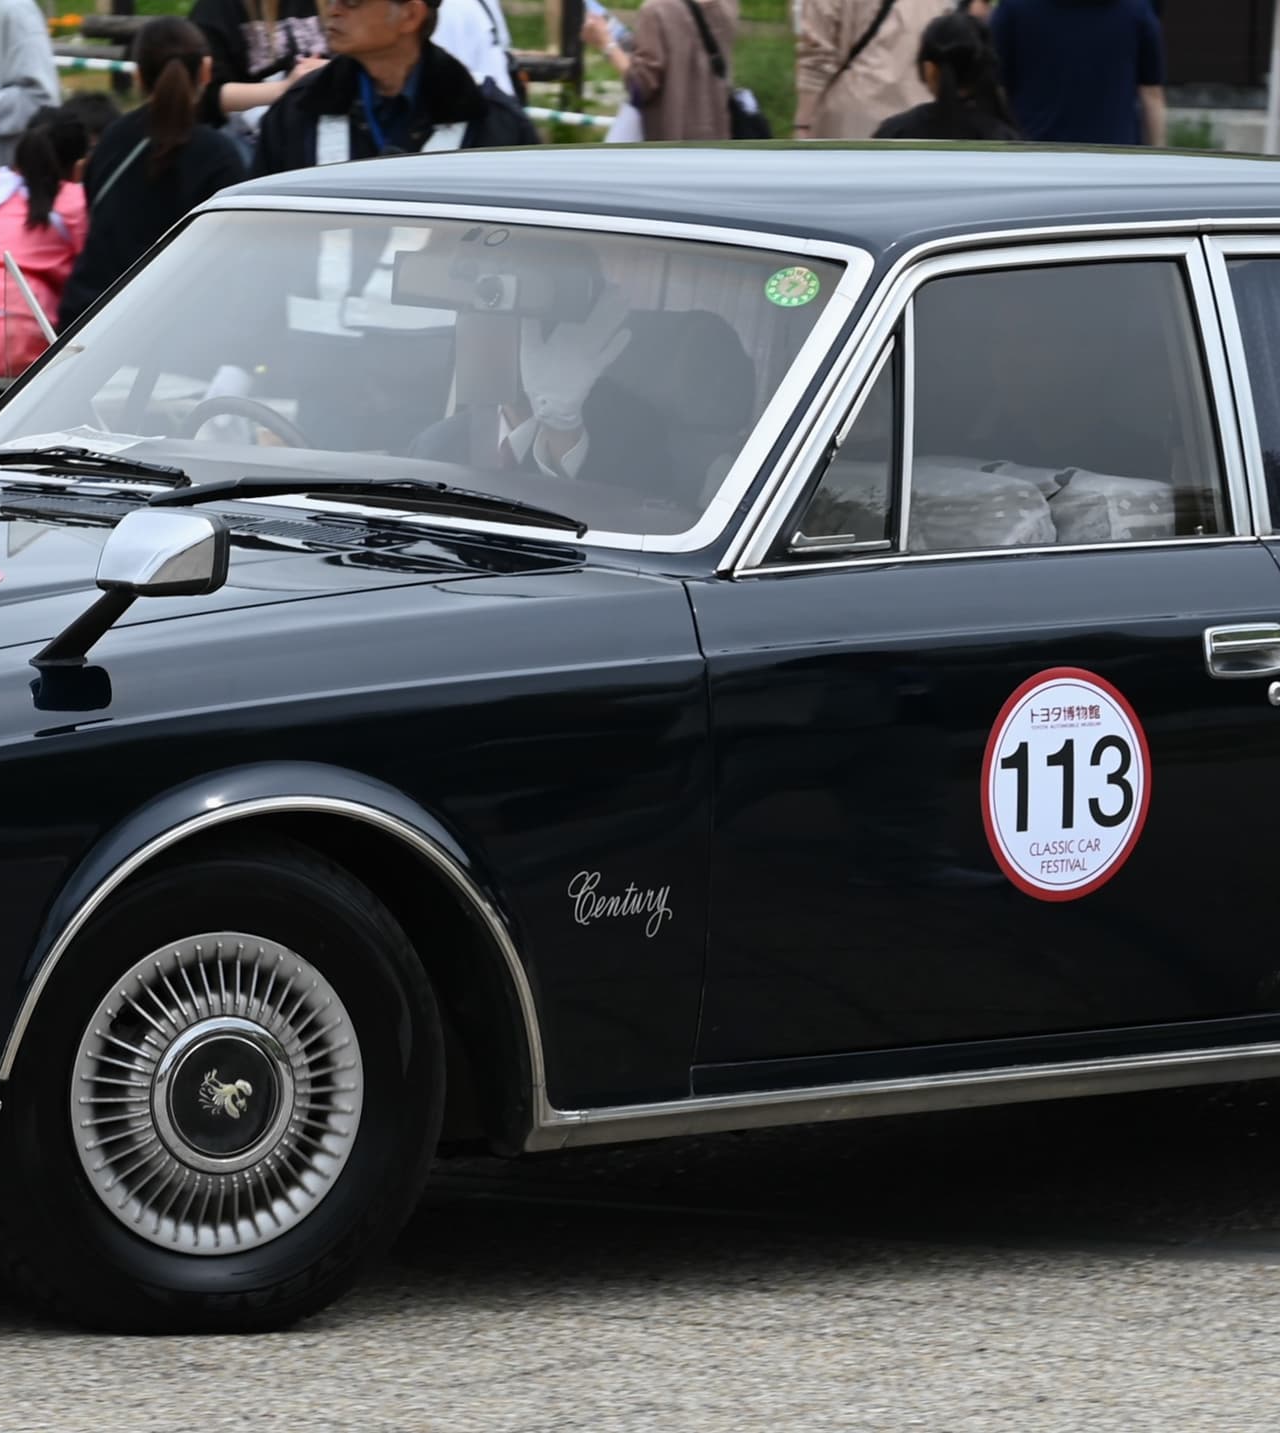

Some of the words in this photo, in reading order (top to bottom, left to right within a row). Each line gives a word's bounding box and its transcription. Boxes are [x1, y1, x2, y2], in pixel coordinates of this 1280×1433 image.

[1030, 704, 1101, 724] トヨタ博物館
[1000, 734, 1134, 832] 113
[1029, 839, 1074, 857] CLASSIC
[1077, 838, 1101, 854] CAR
[1040, 857, 1088, 875] FESTIVAL
[567, 870, 673, 938] Century
